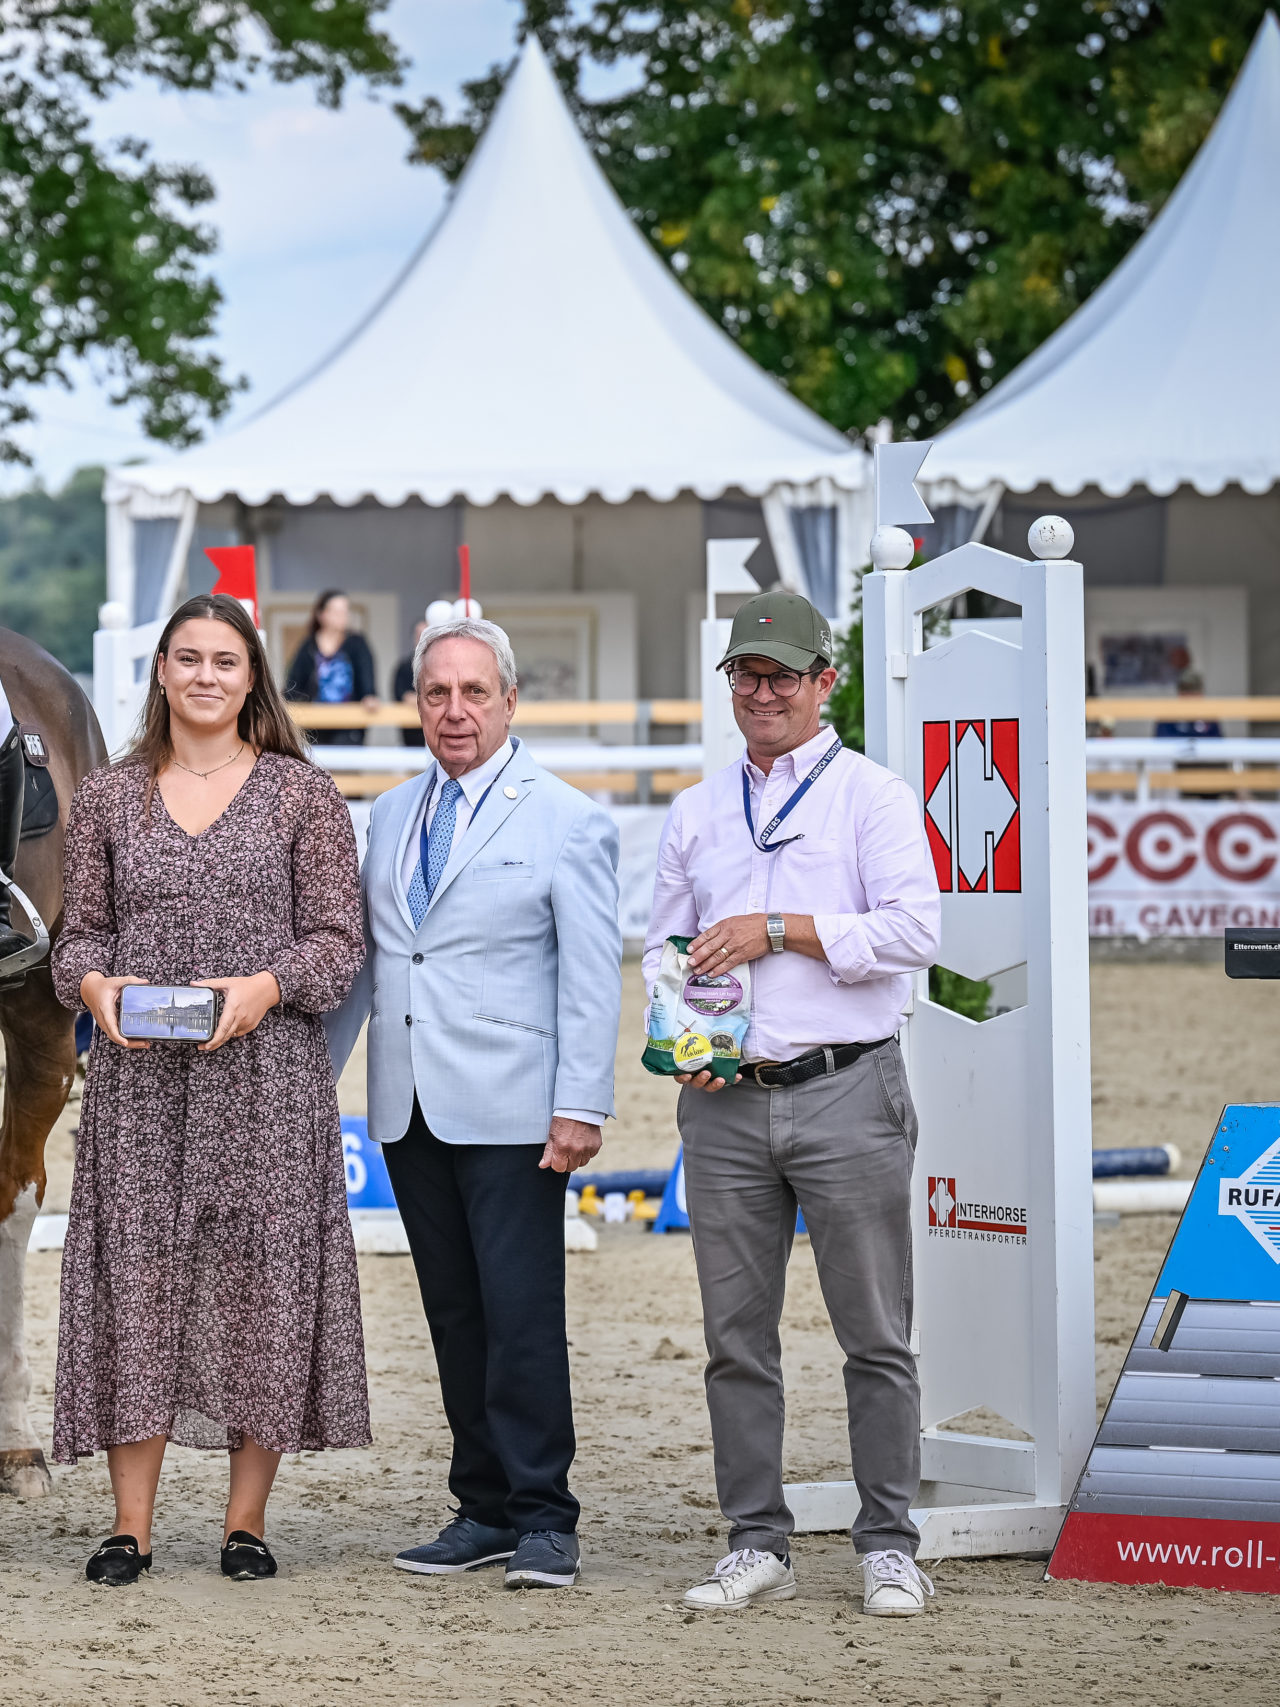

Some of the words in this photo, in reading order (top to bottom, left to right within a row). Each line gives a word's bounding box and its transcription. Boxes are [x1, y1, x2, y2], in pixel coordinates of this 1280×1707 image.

[761, 816, 781, 843] ASTERS
[808, 759, 828, 782] ZURICH
[341, 1132, 368, 1195] 6
[956, 1202, 1027, 1223] INTERHORSE
[928, 1228, 1027, 1246] PFERDETRANSPORTER
[1116, 1539, 1276, 1569] www.roll-
